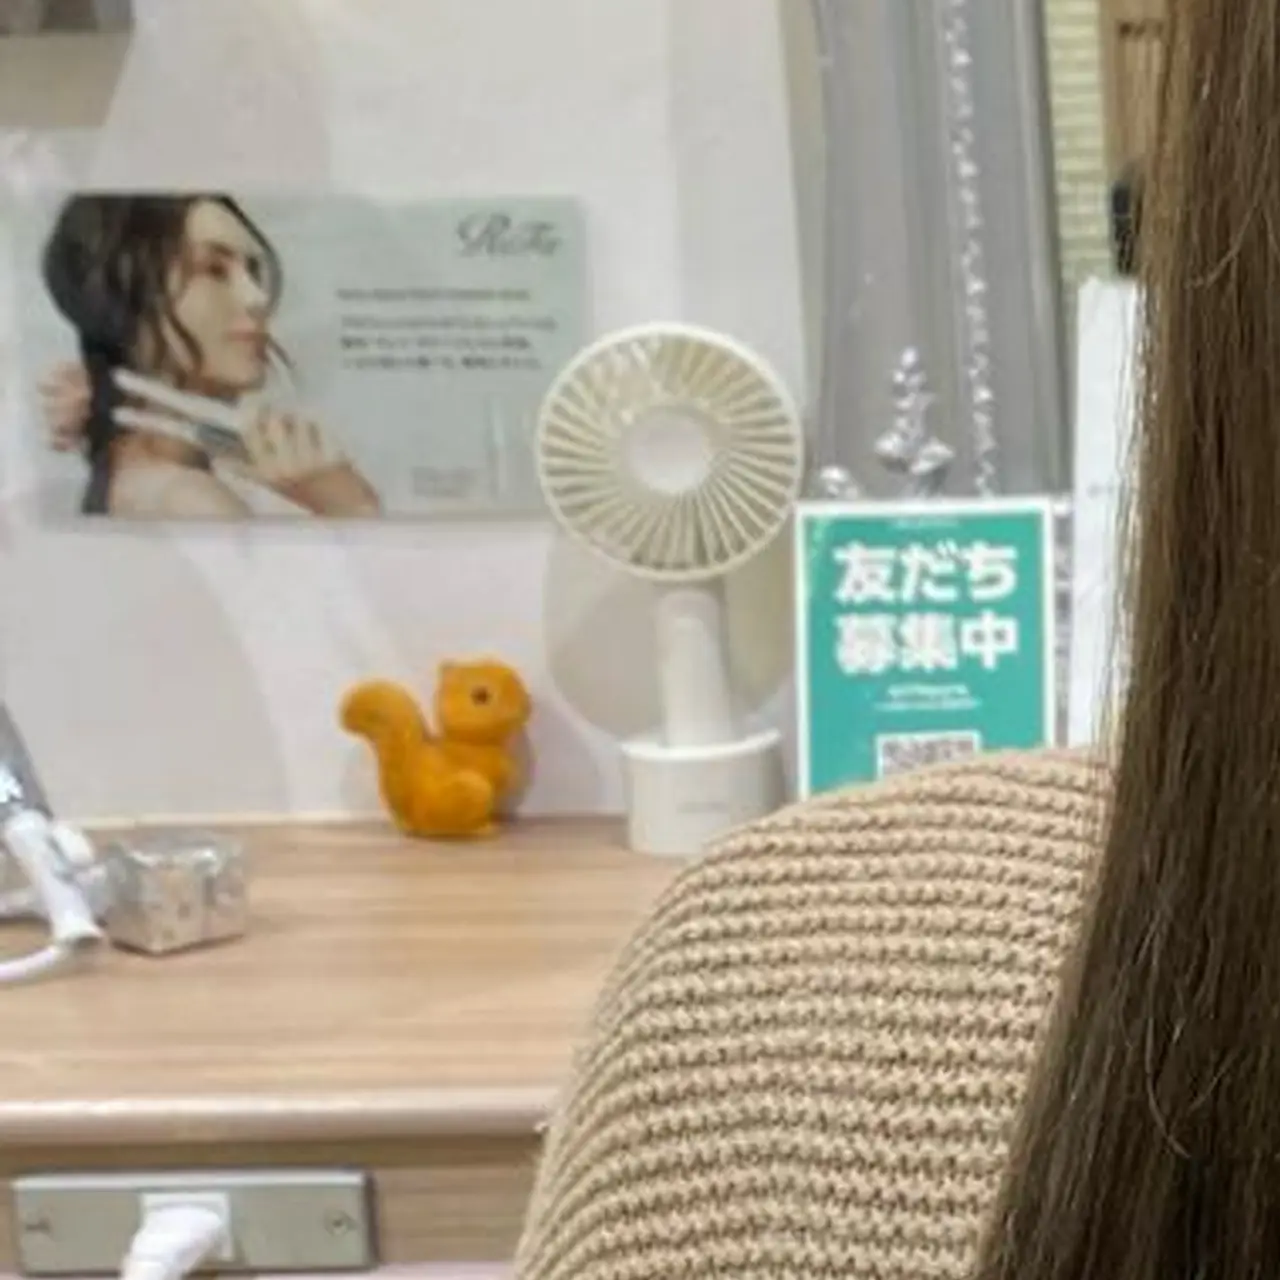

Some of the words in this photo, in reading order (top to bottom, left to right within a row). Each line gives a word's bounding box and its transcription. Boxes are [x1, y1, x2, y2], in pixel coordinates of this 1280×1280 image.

[833, 540, 1018, 604] 友だち
[833, 611, 1019, 676] 募集中
